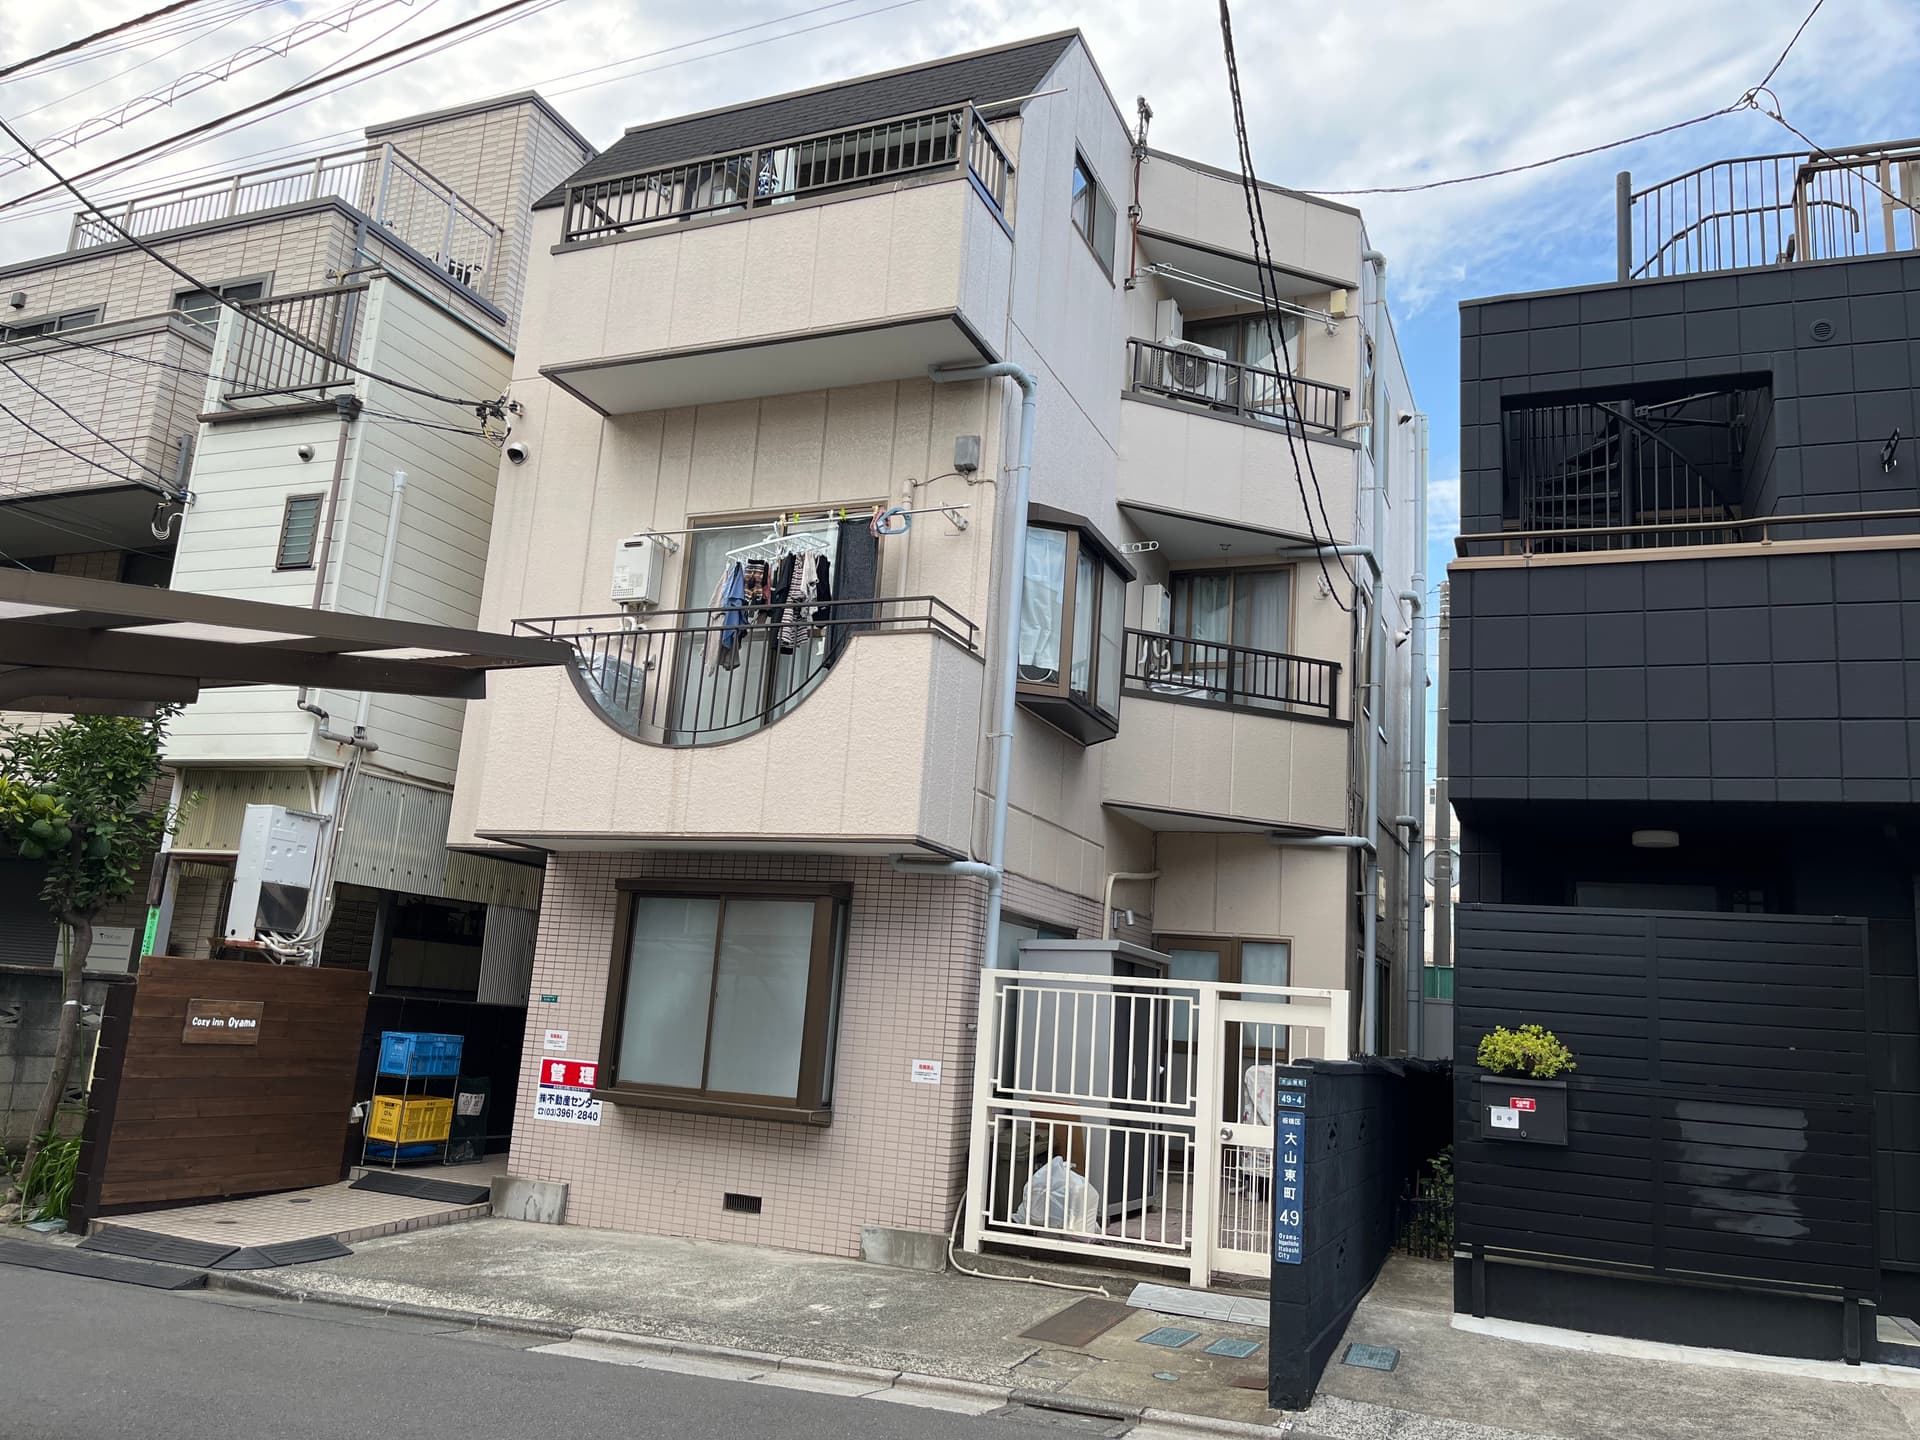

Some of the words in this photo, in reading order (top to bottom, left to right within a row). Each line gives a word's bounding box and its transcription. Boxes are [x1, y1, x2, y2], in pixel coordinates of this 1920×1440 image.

[192, 1016, 211, 1027] Cozy
[228, 1016, 256, 1028] Oyama
[1281, 1094, 1302, 1105] 49-4
[1284, 1132, 1297, 1200] 大山東町
[1279, 1209, 1300, 1226] 49
[1278, 1252, 1290, 1260] City
